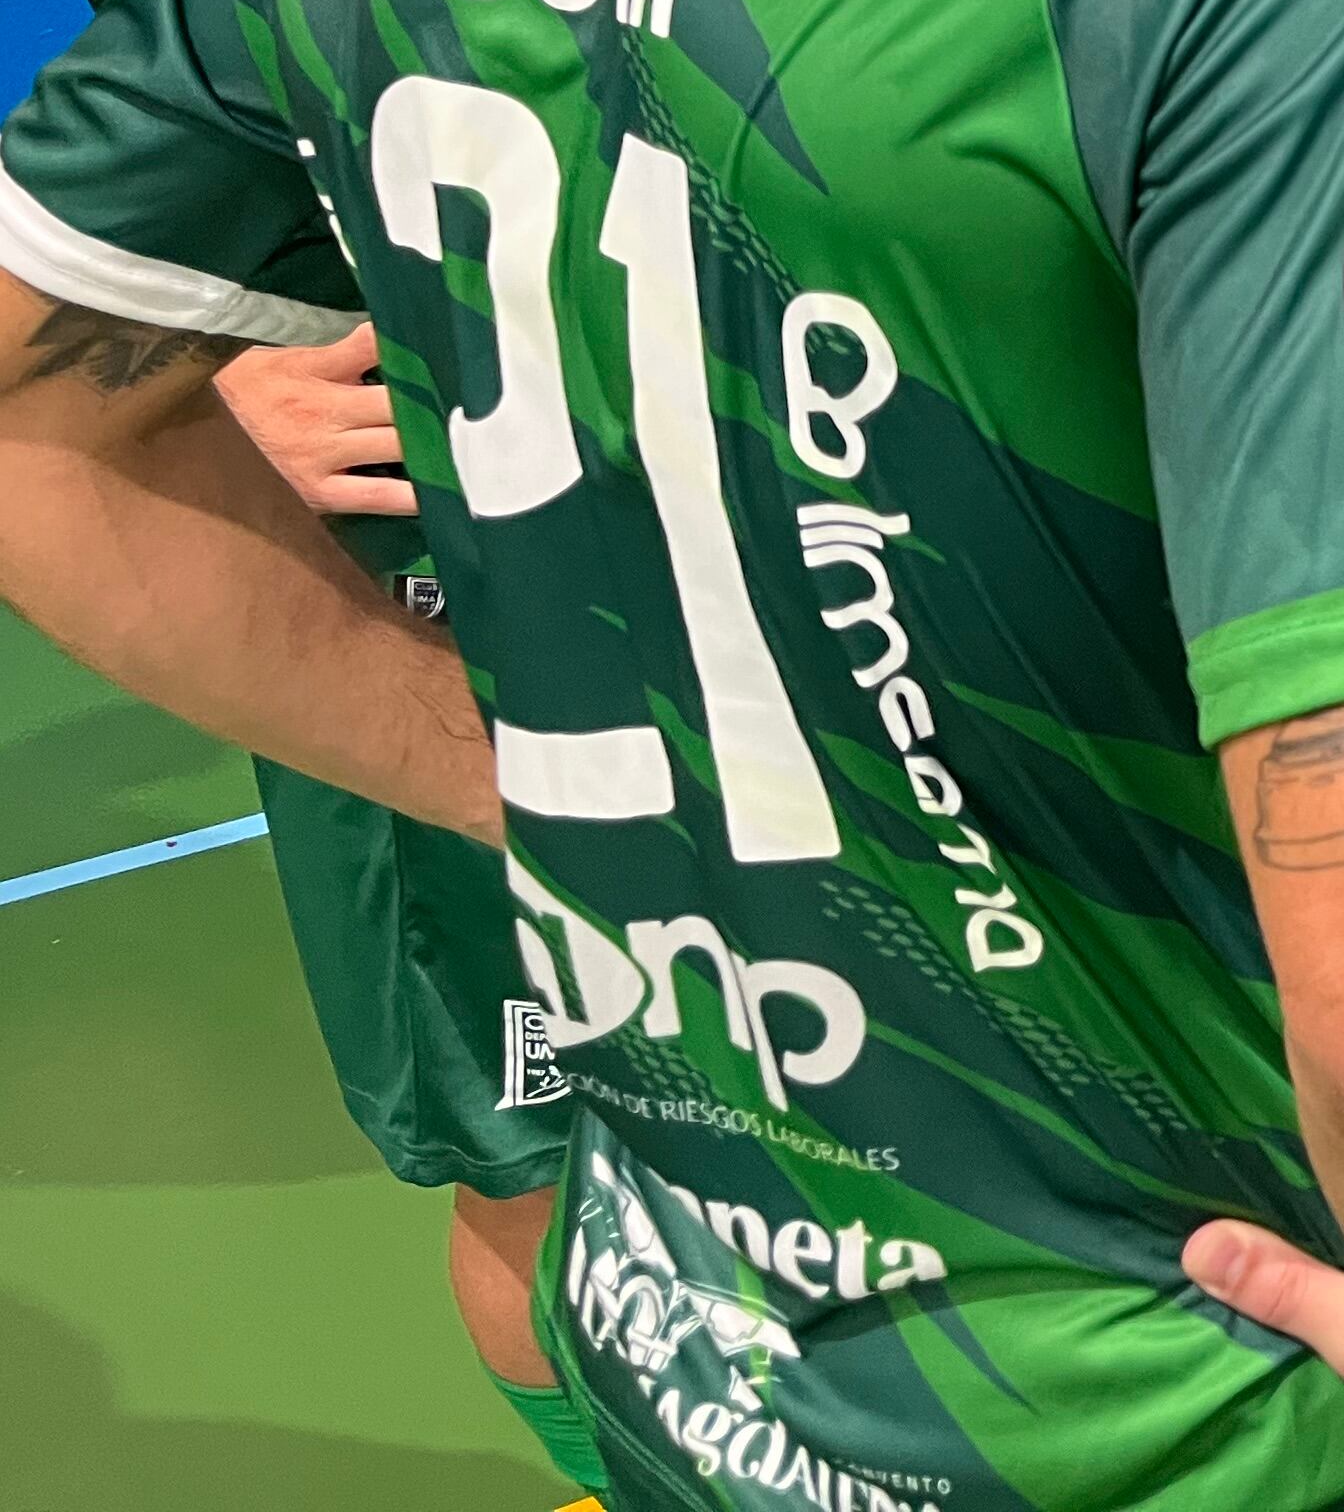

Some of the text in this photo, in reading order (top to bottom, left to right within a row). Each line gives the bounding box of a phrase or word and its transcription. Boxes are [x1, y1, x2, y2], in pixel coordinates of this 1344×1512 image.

[370, 75, 842, 862] 21
[627, 1093, 652, 1119] DE
[661, 1099, 762, 1137] RIESGOS
